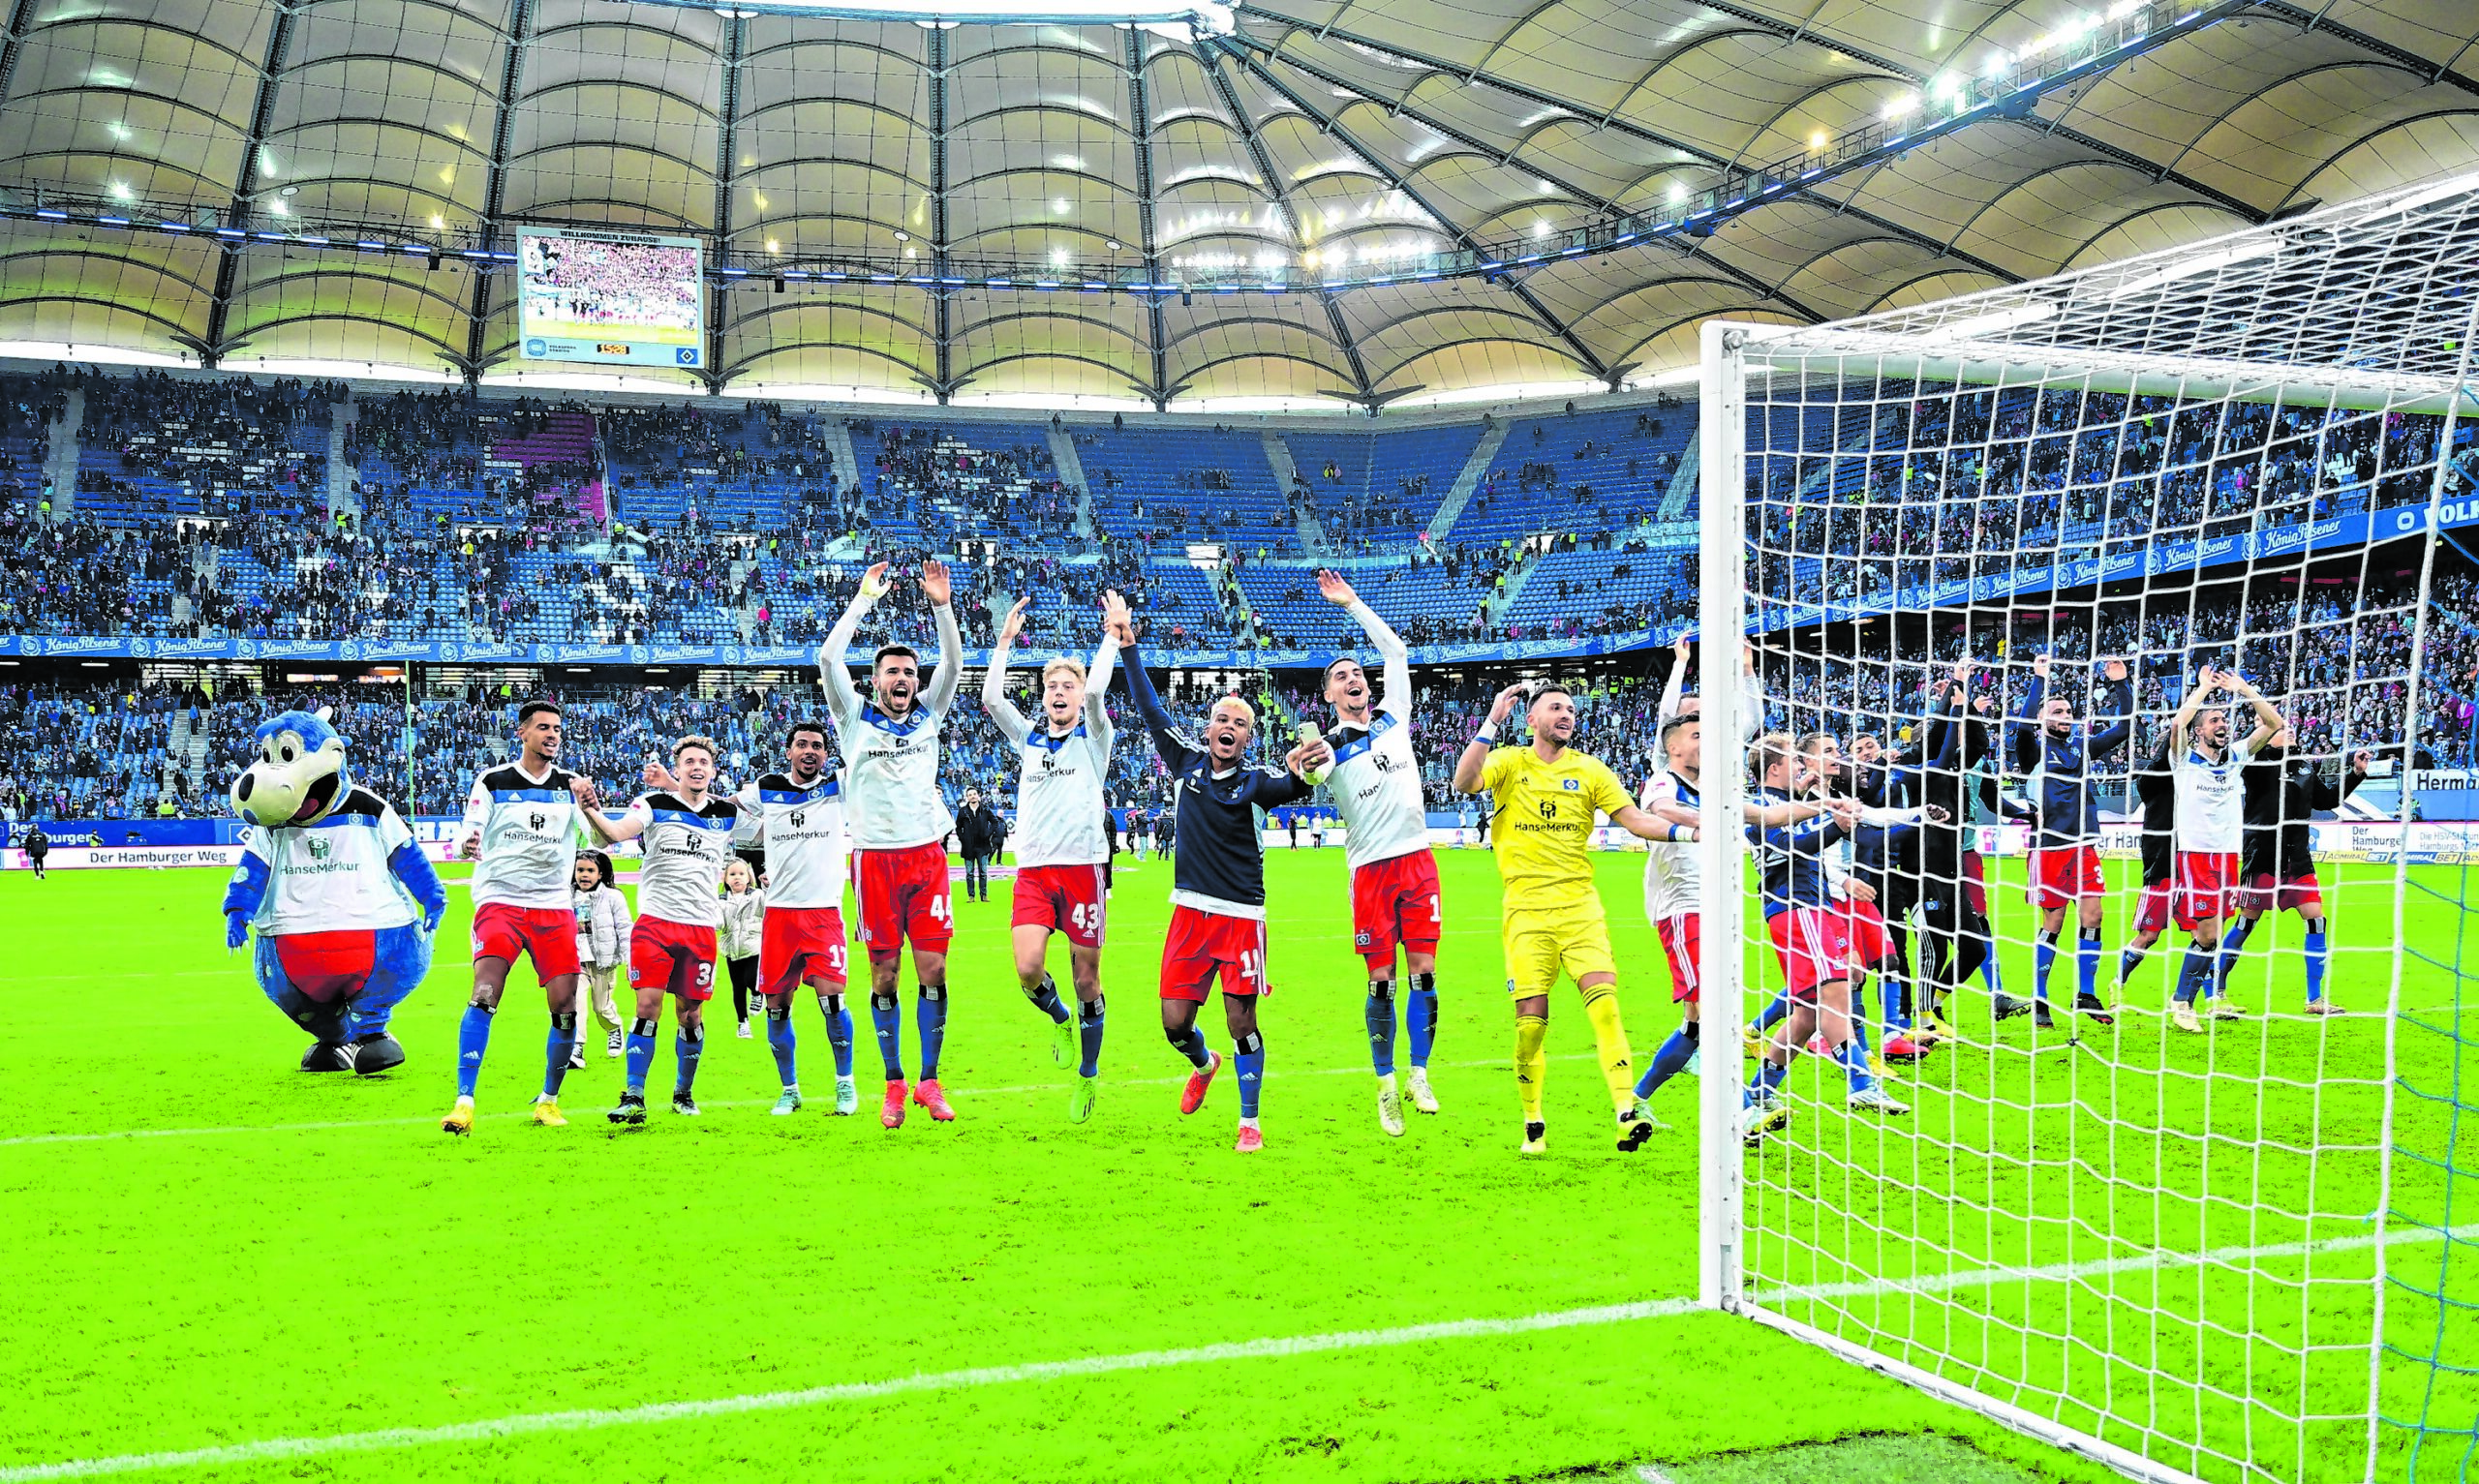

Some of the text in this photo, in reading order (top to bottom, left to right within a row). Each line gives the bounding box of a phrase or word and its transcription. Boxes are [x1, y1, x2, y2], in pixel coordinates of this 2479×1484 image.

[2298, 520, 2341, 541] Pisener
[45, 637, 80, 651] König
[154, 639, 190, 652] König
[260, 641, 292, 654] König
[2416, 772, 2479, 791] Herma
[504, 831, 563, 845] HanseMerku
[2352, 835, 2402, 848] Hamburge
[90, 850, 228, 864] Der Hamburger Weg
[279, 860, 360, 875] HanseMerkur
[1071, 902, 1099, 929] 43
